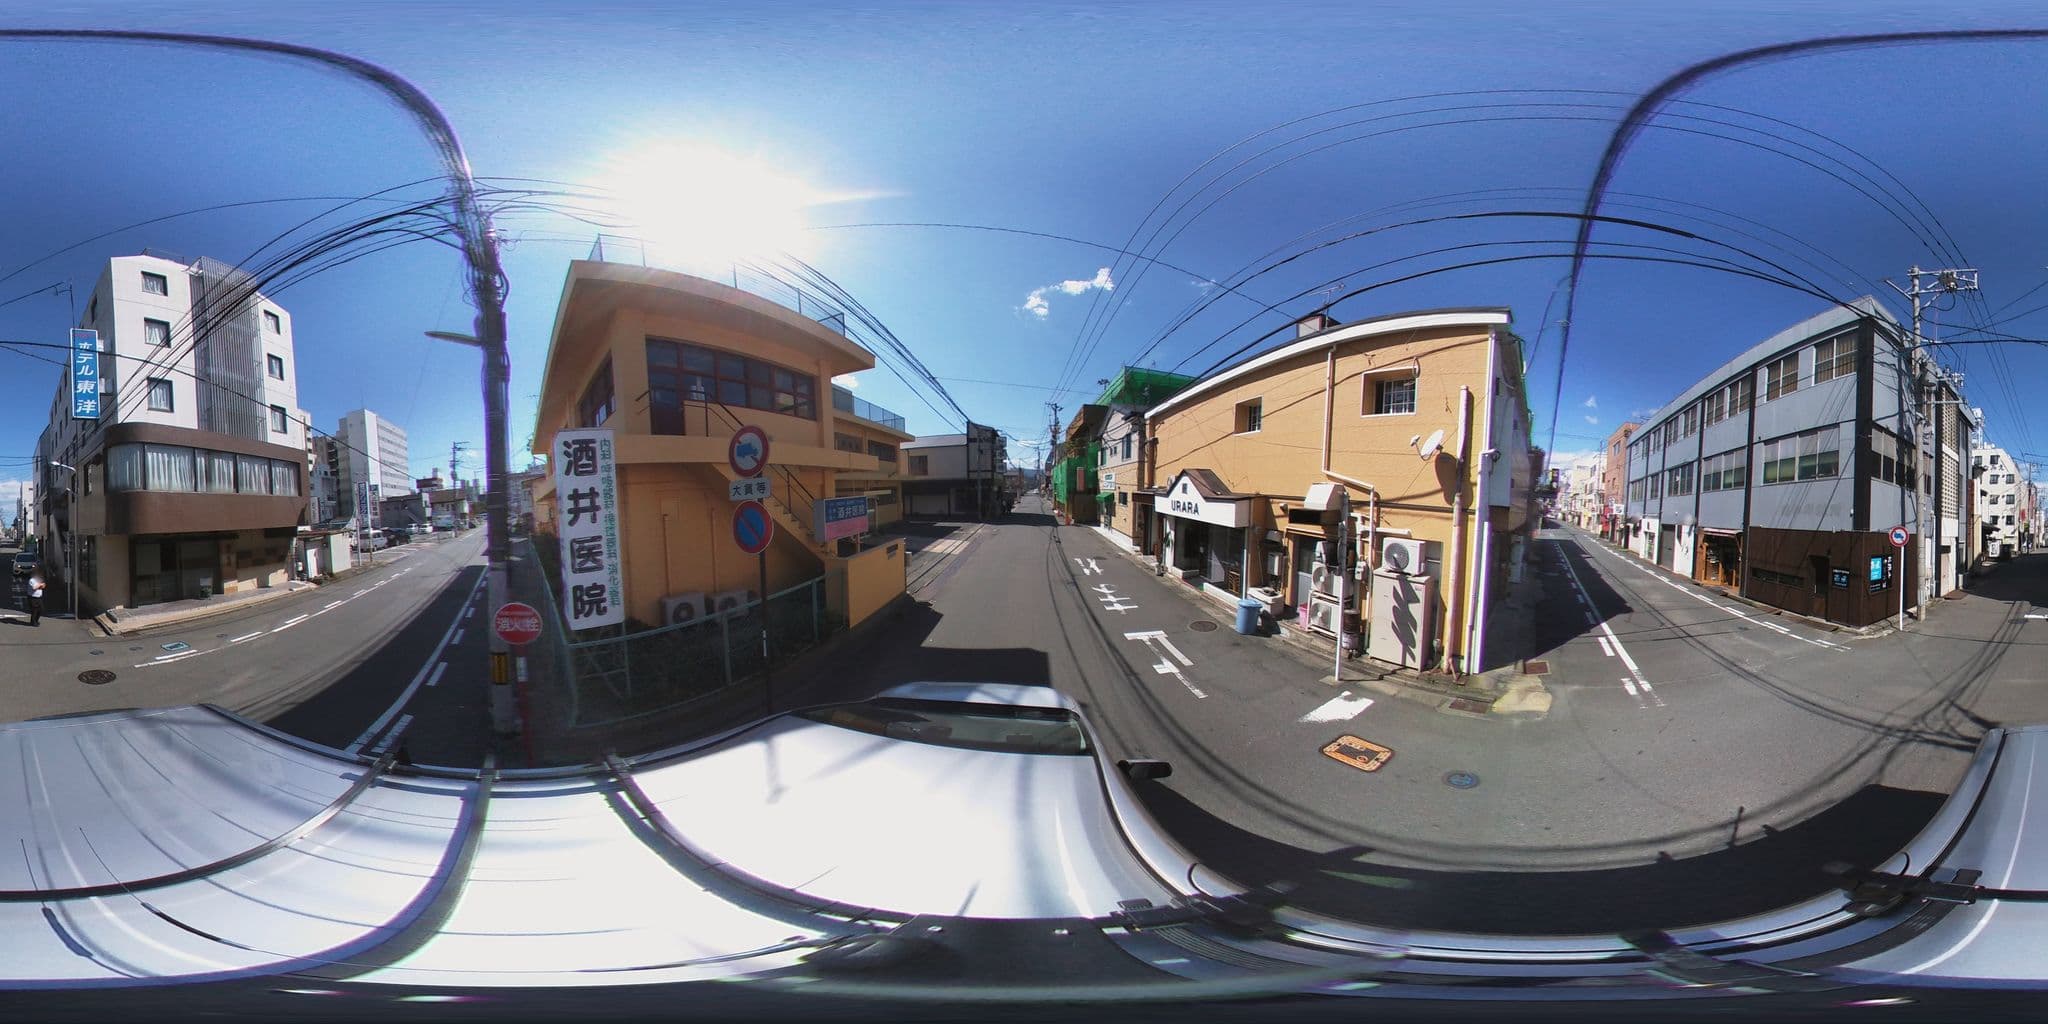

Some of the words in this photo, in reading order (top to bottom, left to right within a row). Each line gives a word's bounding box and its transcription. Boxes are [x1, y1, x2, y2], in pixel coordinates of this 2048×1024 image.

[76, 342, 97, 414] ホテル東洋
[563, 438, 607, 619] 酒井医院
[1171, 500, 1200, 515] URARA
[497, 617, 540, 632] 消火栓
